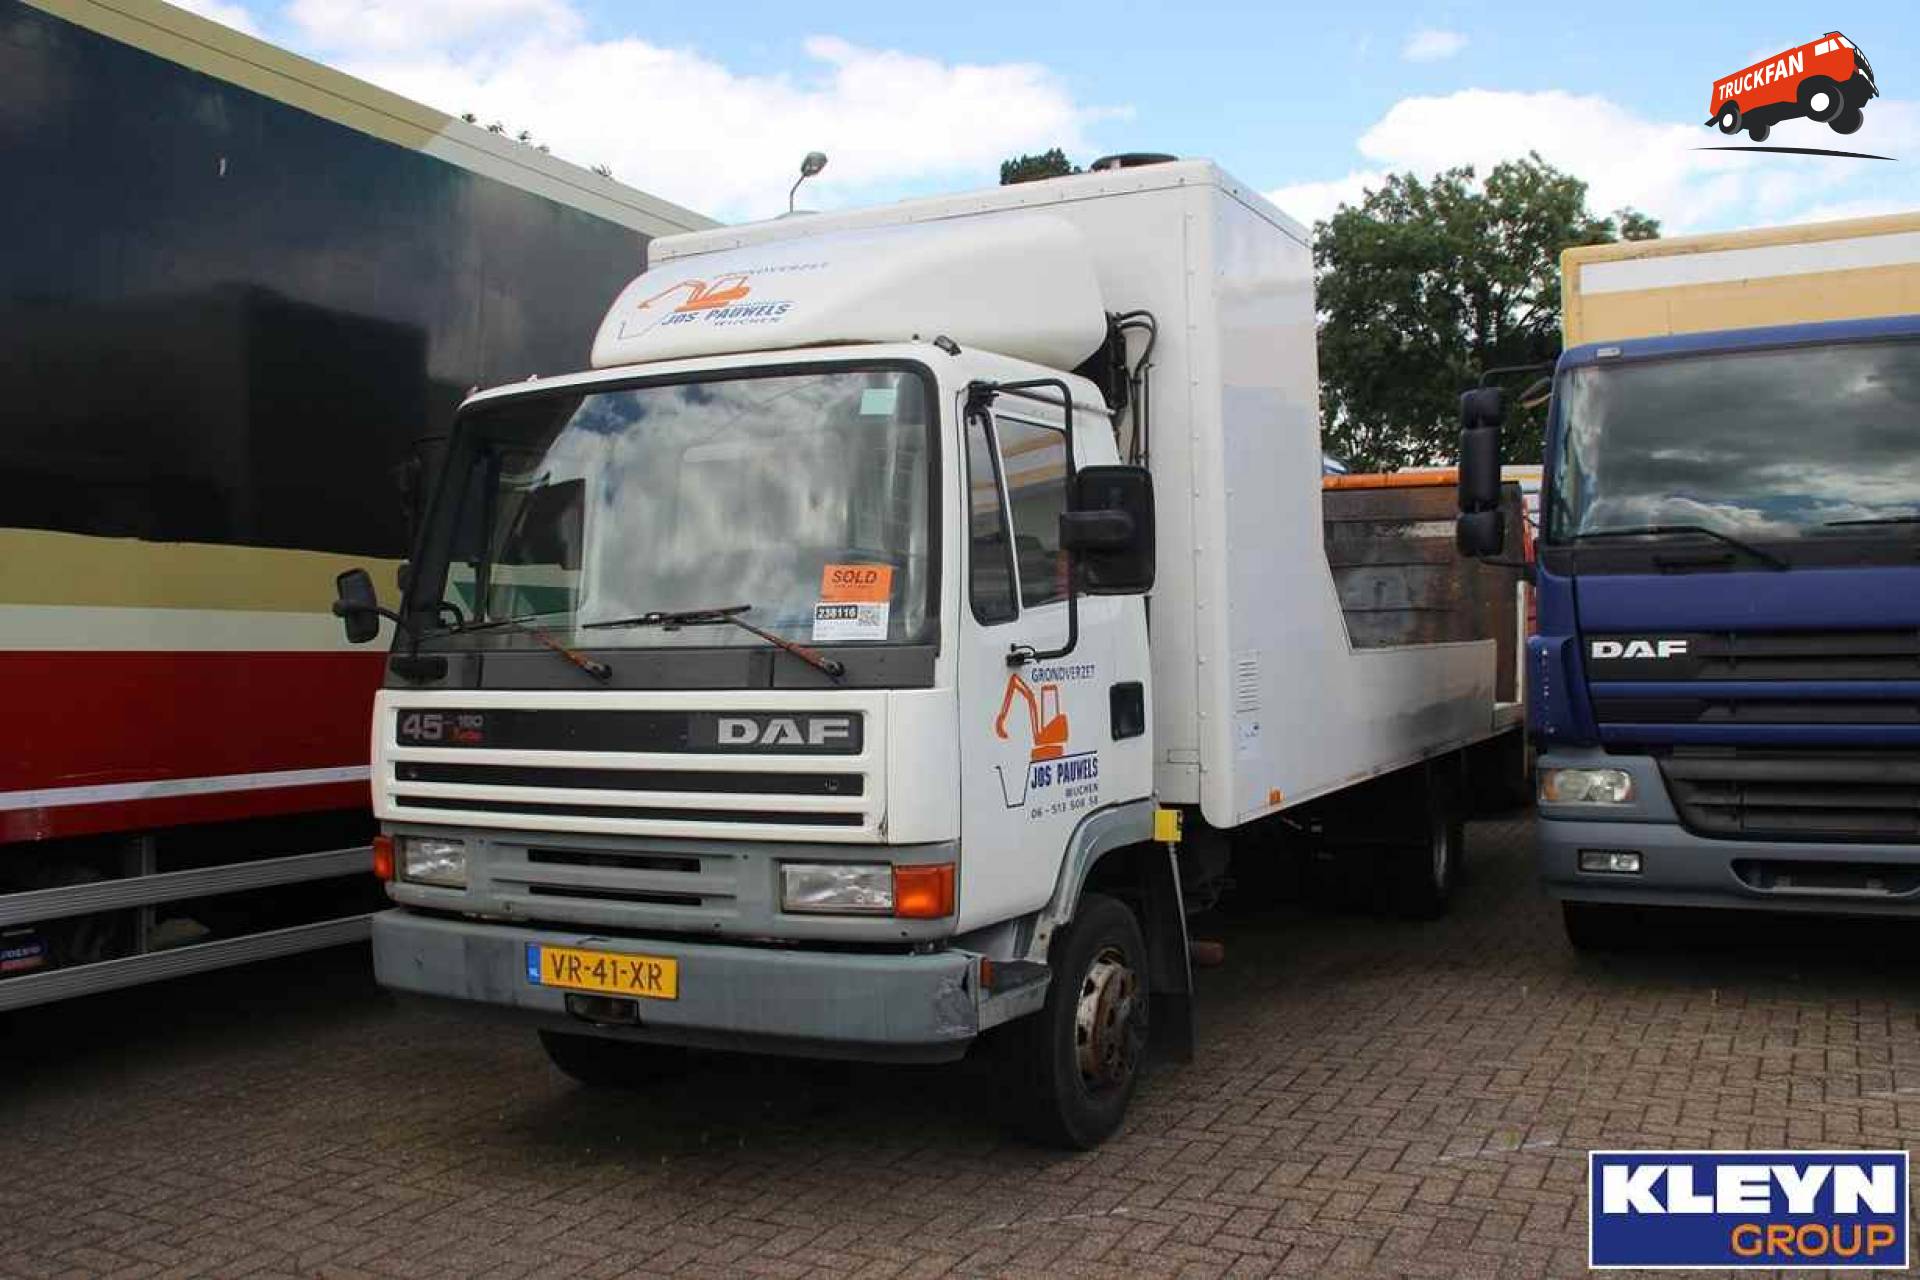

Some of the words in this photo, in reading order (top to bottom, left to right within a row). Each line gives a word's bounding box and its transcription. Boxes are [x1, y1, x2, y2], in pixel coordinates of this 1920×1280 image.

[662, 310, 698, 326] JOS
[704, 303, 791, 321] PAUWELS
[832, 570, 877, 583] SOLD
[1592, 640, 1687, 659] DAF
[1031, 664, 1096, 683] GRONDVERZET
[718, 717, 850, 744] DAF
[1030, 764, 1051, 789] JOS
[1056, 757, 1099, 785] PAUWELS
[551, 952, 662, 991] VR-41-XR
